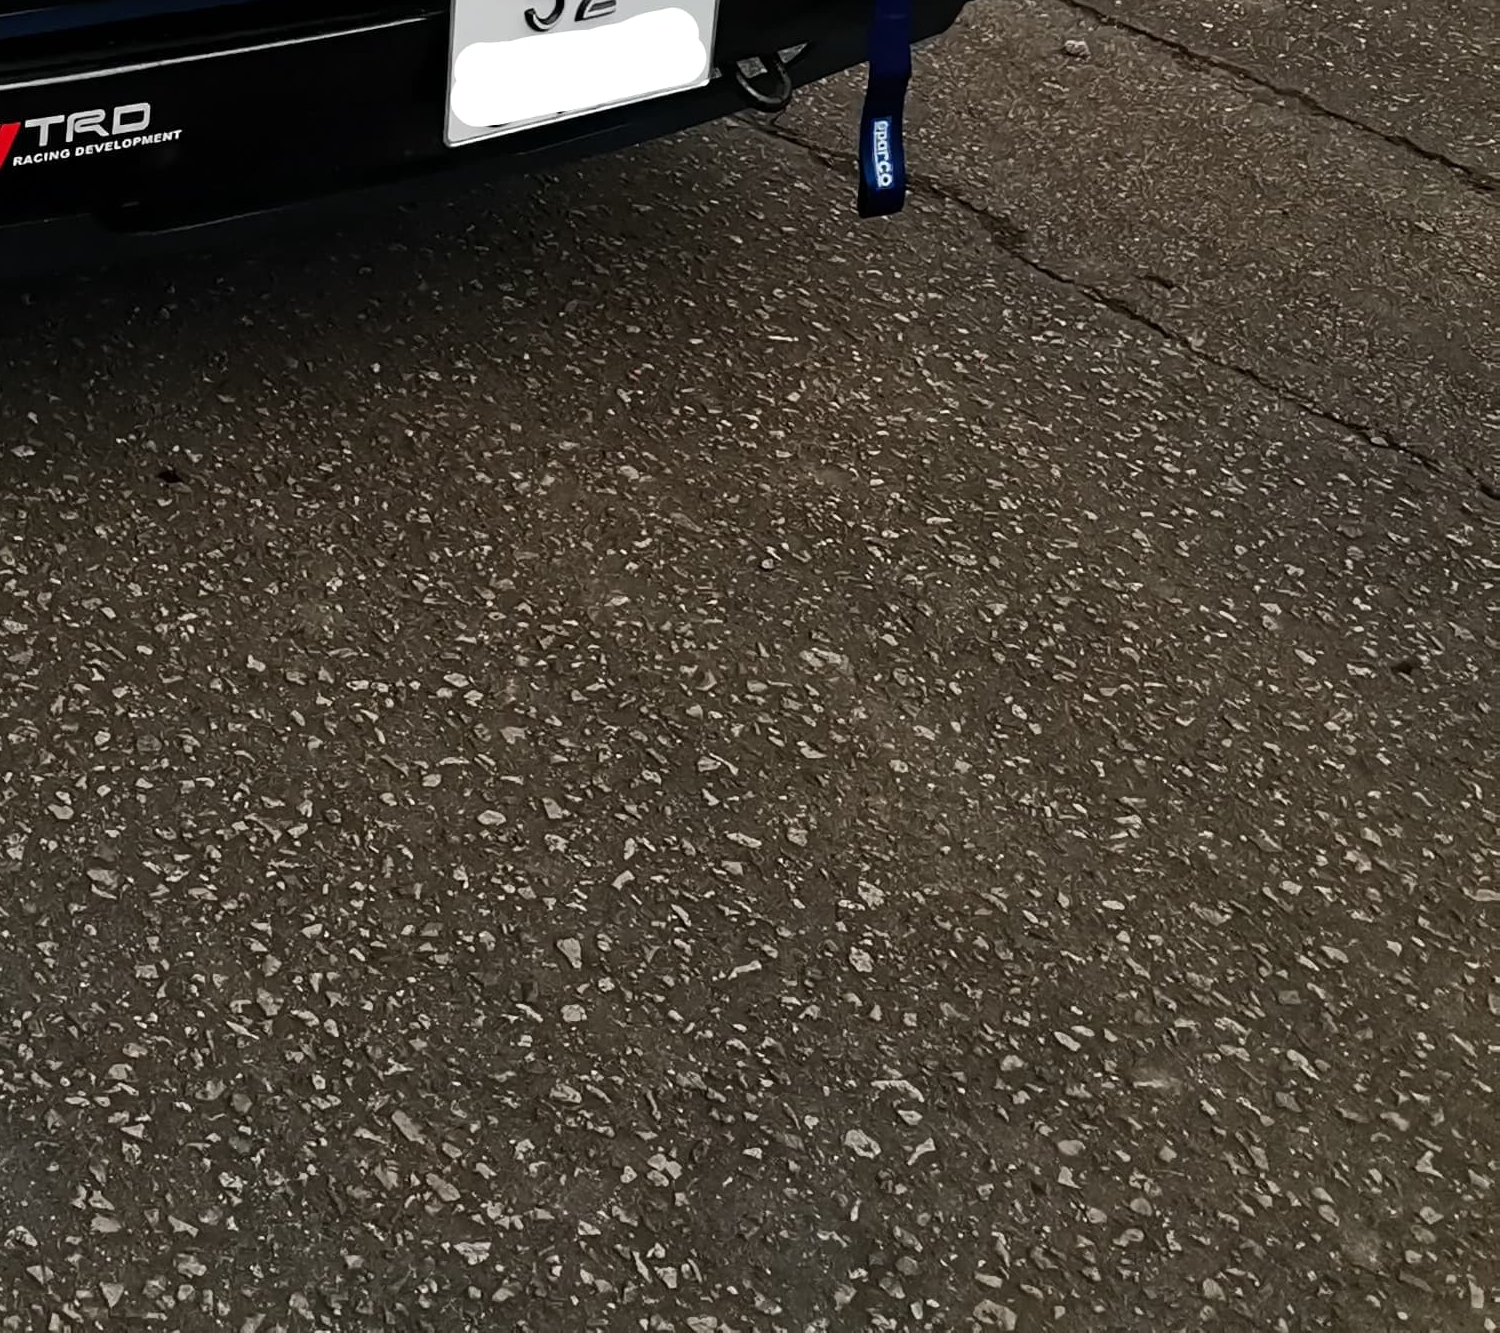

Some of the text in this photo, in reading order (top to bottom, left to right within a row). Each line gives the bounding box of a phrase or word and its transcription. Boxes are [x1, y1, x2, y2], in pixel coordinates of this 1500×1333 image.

[24, 101, 152, 148] TRD
[12, 128, 183, 167] RACING DEVELOPMENT
